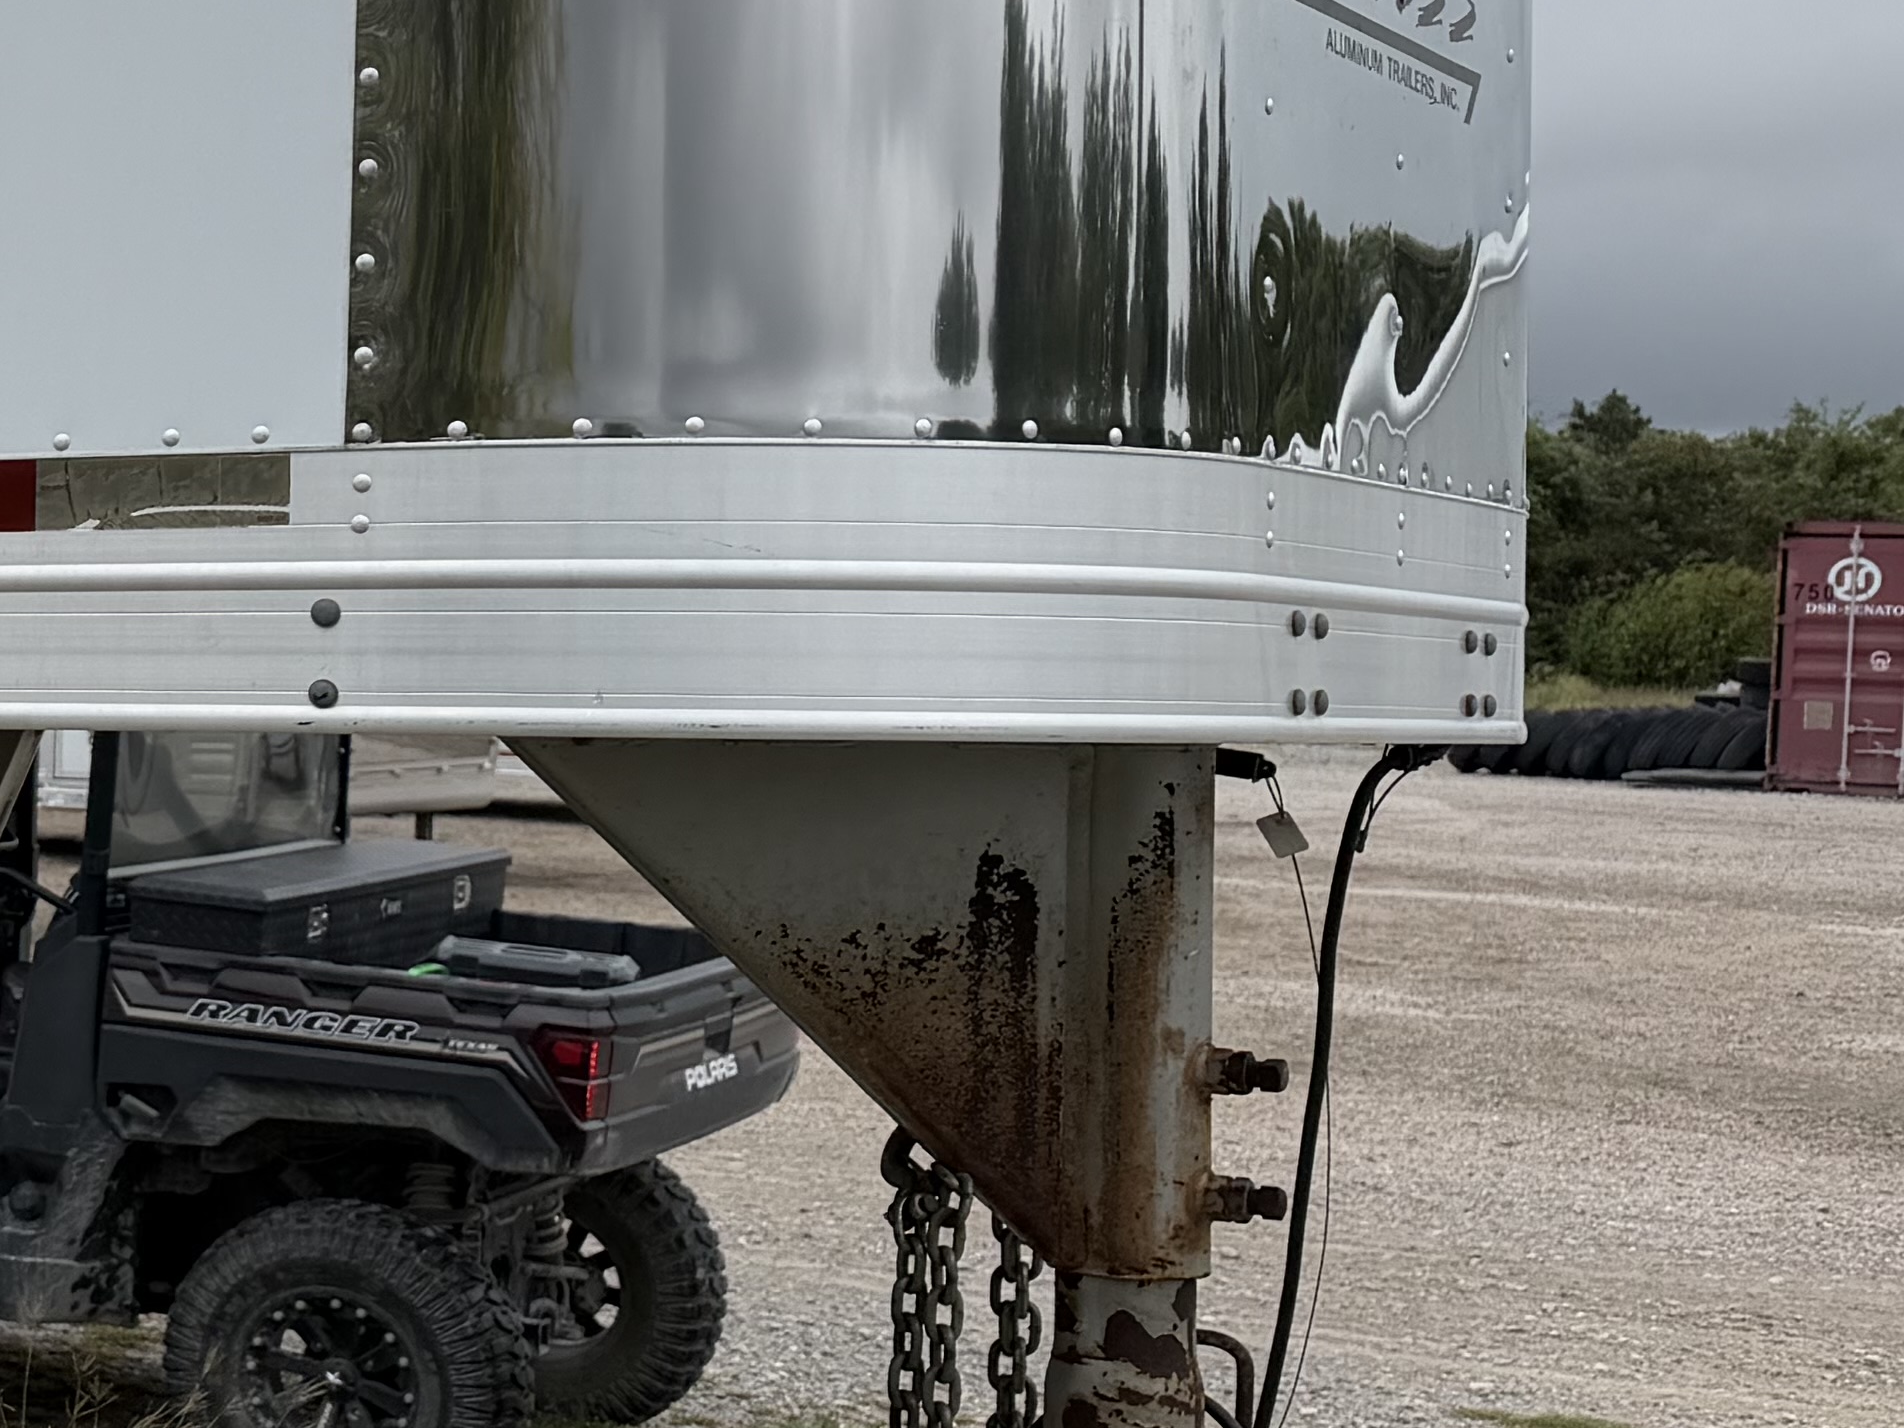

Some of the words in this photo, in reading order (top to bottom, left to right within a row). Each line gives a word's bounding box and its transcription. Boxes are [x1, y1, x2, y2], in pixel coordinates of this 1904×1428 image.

[1325, 27, 1384, 76] ALUMINUM
[1387, 56, 1439, 105] TRAILERS,
[1440, 82, 1460, 112] INC.
[187, 998, 421, 1044] RANGER
[685, 1053, 738, 1091] POLARIS
